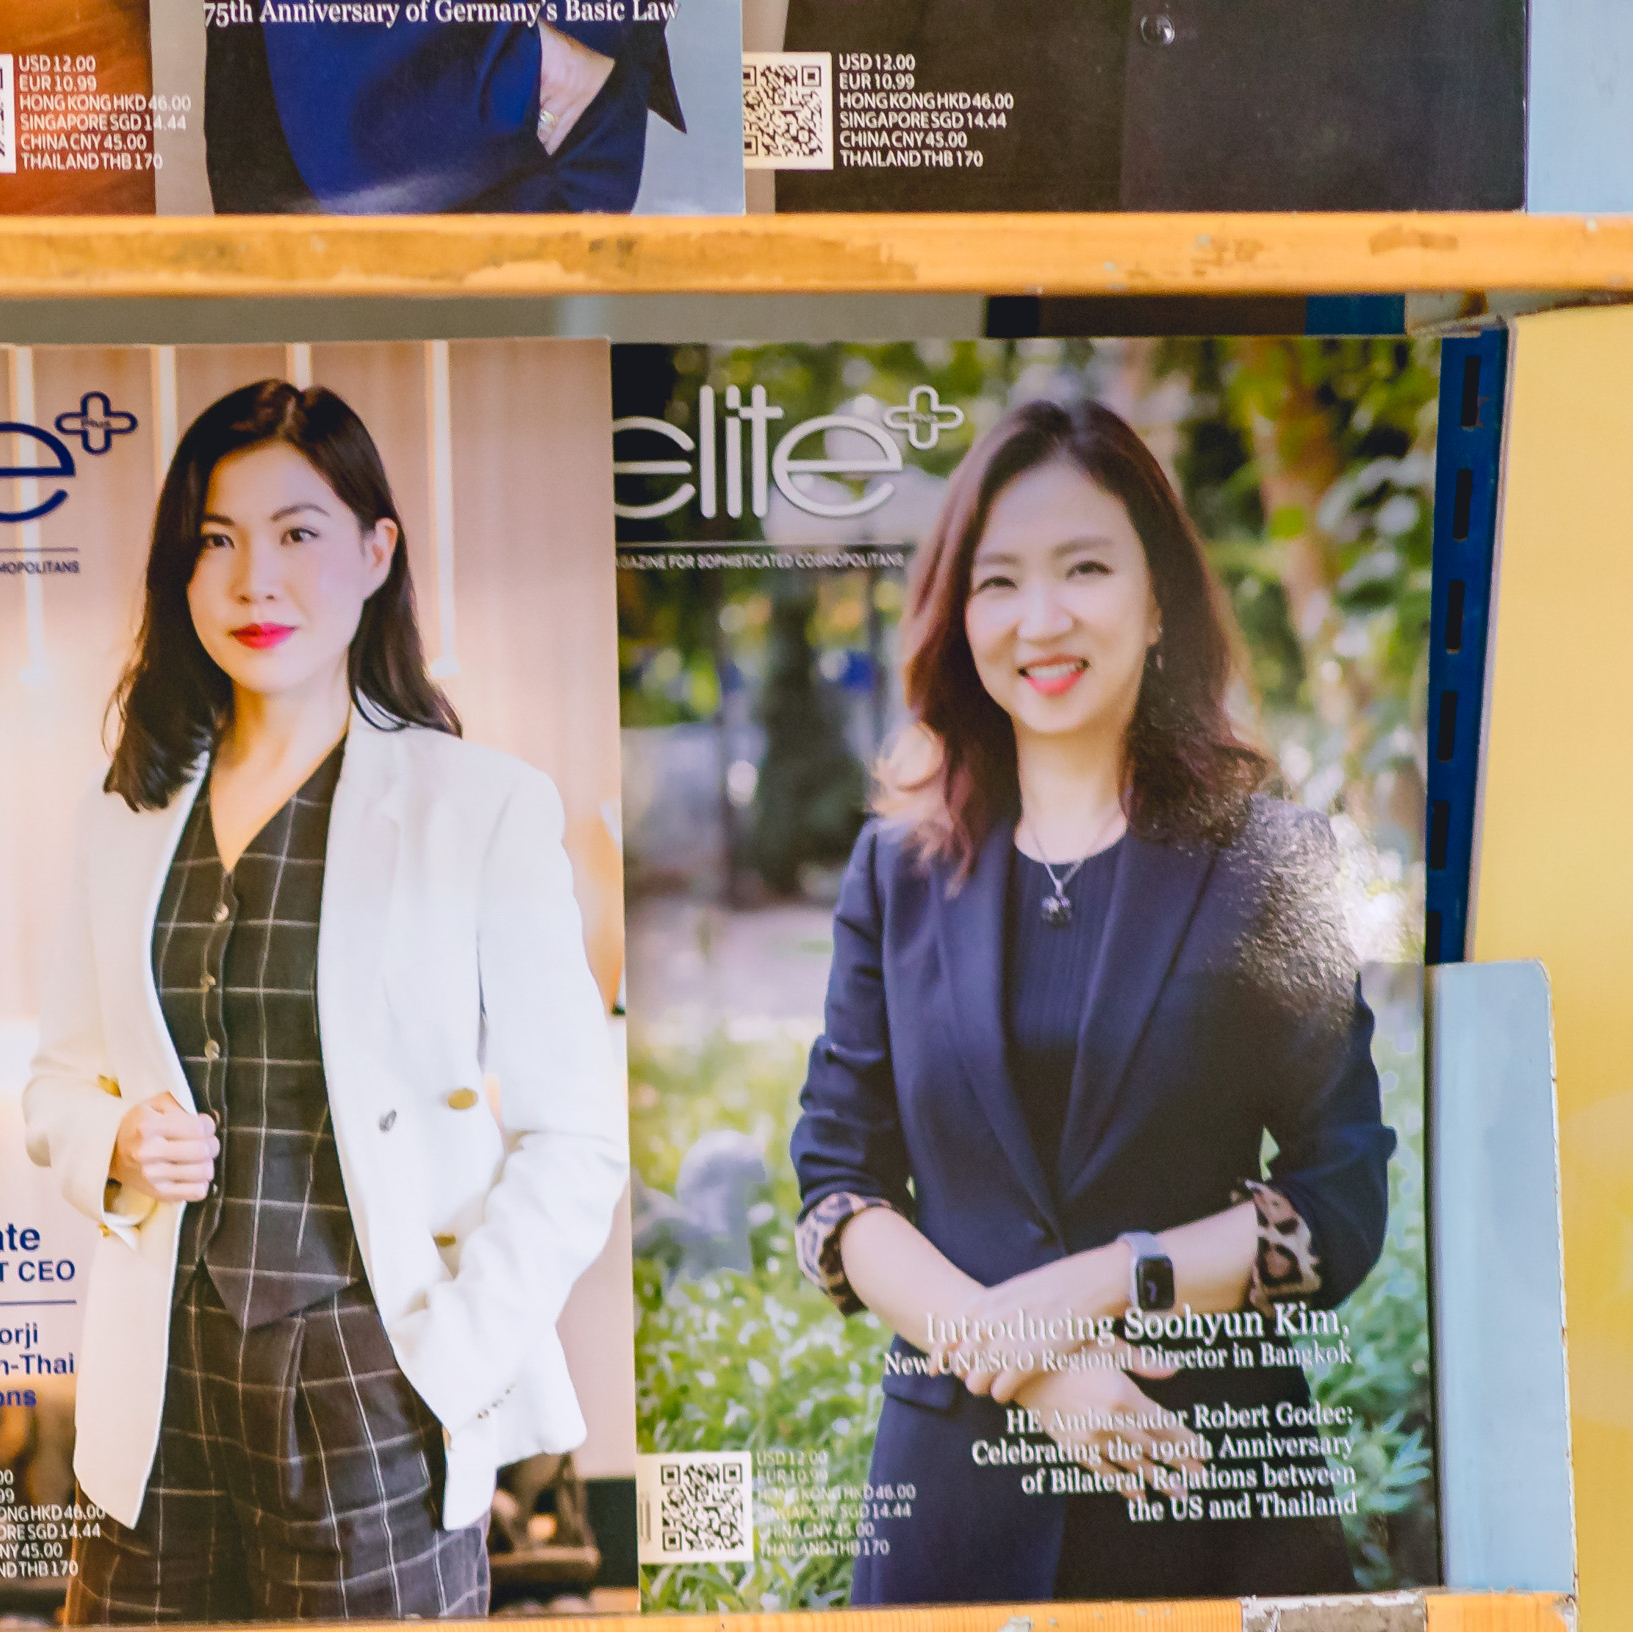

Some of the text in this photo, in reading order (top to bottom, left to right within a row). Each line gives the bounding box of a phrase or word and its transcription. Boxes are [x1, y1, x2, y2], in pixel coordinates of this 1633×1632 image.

[204, 0, 679, 29] 75th Anniversary of Germany's Basic Law
[839, 53, 916, 70] USD 12.00
[839, 73, 915, 90] EUR 10.99
[839, 92, 1014, 109] HONG KONG HKD 46.00
[840, 111, 1007, 129] SINGAPORE SGD 14.44
[840, 131, 967, 148] CHINA CNY 45.00
[840, 150, 983, 167] THAILAND THB 170
[18, 1260, 75, 1283] CEO
[926, 1302, 1350, 1346] Introducing Soohyun Kim,
[1006, 1403, 1353, 1436] HE Ambassador Robert Godec:
[971, 1439, 1101, 1468] Celebrating
[1107, 1437, 1142, 1460] the
[1220, 1434, 1354, 1461] Anniversary
[1021, 1463, 1356, 1496] of Bilateral Relations between
[1128, 1492, 1357, 1523] the US and Thailand
